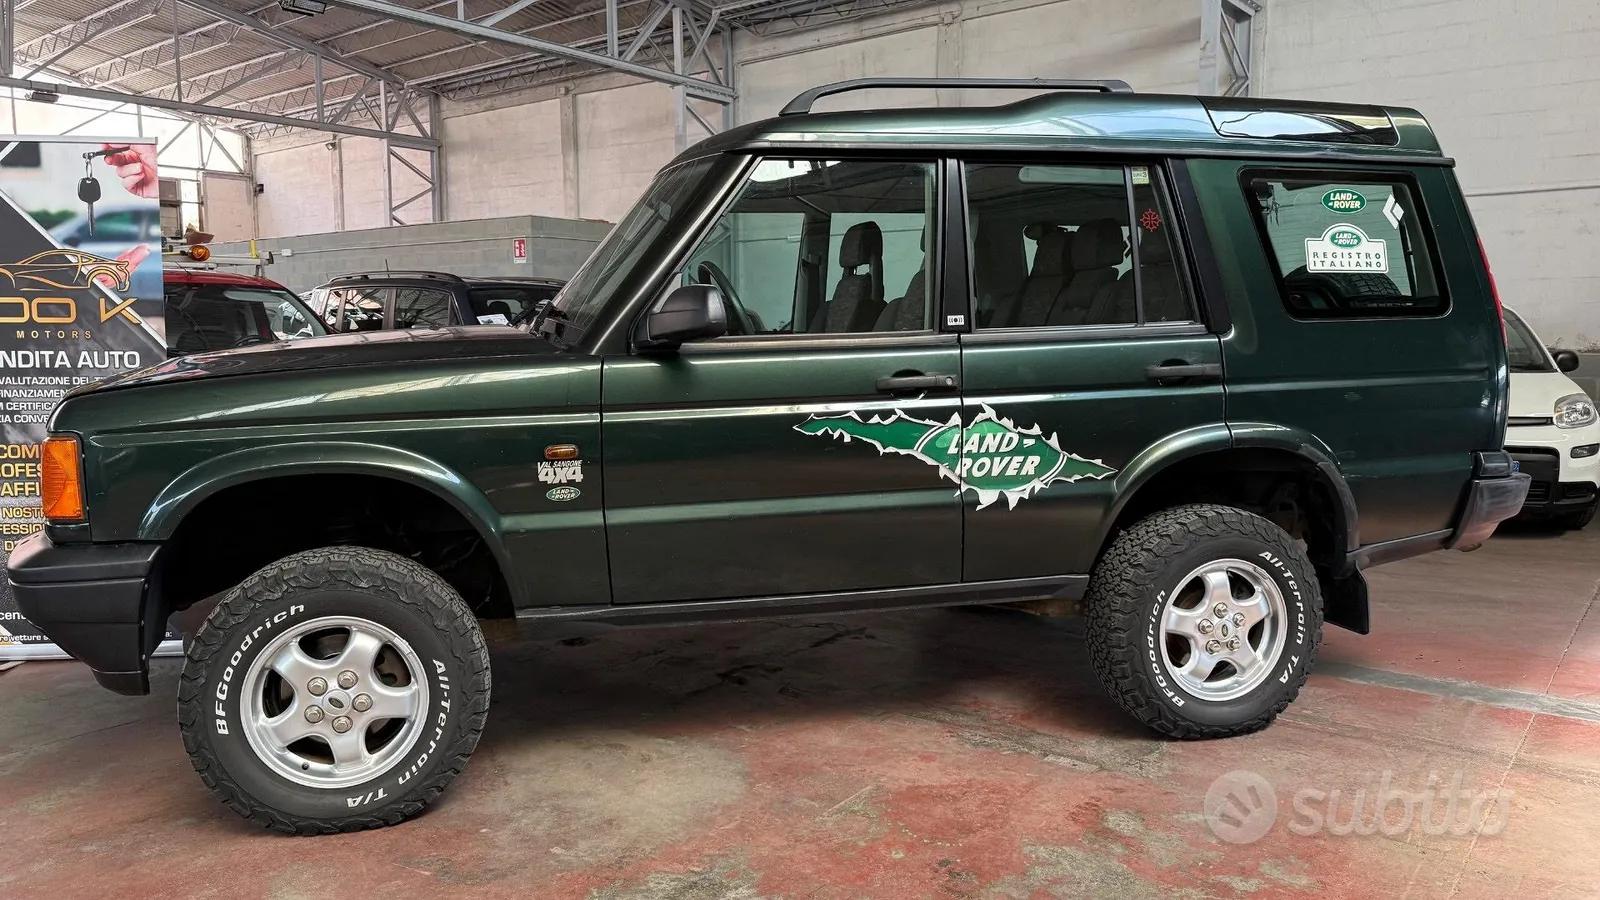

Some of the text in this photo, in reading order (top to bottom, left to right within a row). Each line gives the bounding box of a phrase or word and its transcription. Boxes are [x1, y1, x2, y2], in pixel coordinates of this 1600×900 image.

[1330, 192, 1352, 200] LAND
[1333, 200, 1360, 209] ROVER
[1312, 252, 1381, 260] REGISTRO
[1313, 260, 1382, 268] ITALIANO
[16, 330, 92, 339] MOTORS
[0, 350, 141, 369] NDITA AUTO
[954, 455, 1040, 477] ROVER
[0, 523, 45, 535] ESSIO
[1258, 550, 1306, 685] All-Terrain T/A
[1147, 589, 1185, 707] BFGoodrich
[215, 602, 305, 735] BFGoodrich
[346, 658, 450, 808] All-Terrain T/A
